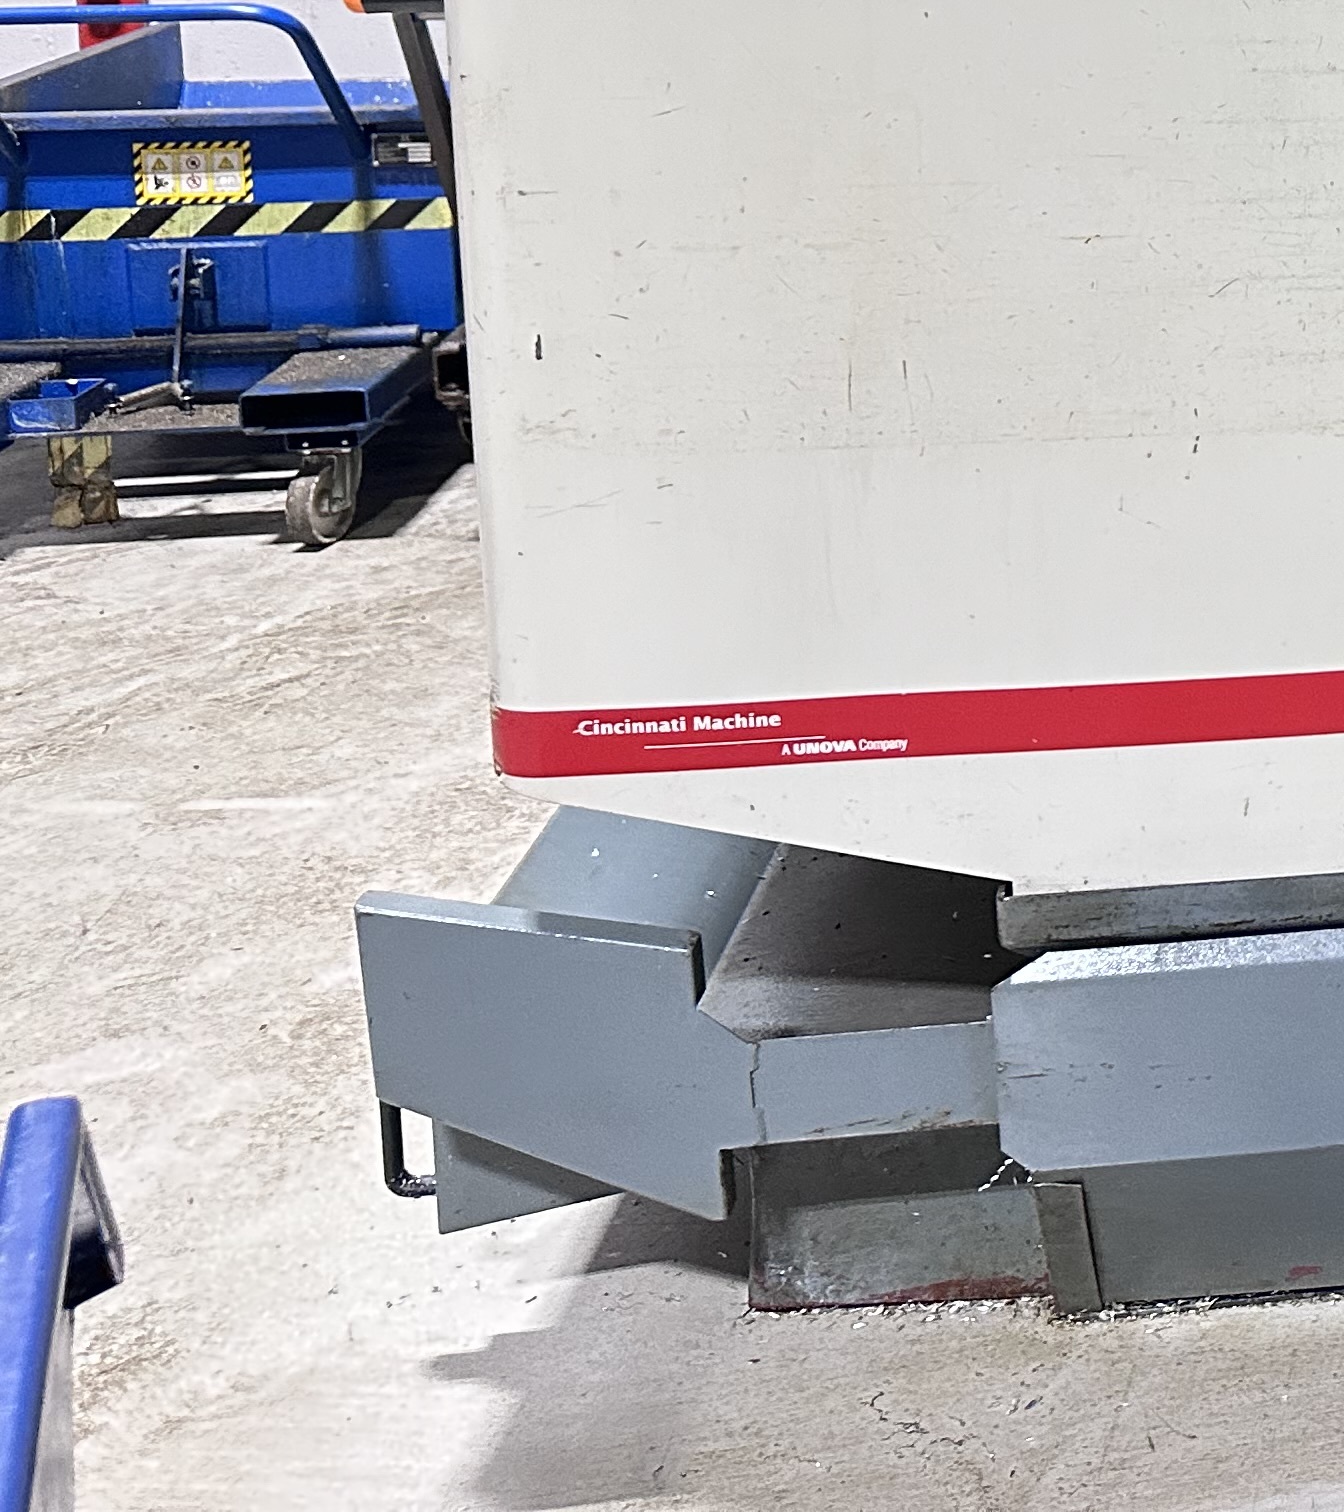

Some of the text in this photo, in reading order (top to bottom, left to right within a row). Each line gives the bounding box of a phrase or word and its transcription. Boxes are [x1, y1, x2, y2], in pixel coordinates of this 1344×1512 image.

[574, 712, 782, 736] Cincinnati Machine
[781, 738, 909, 756] A UNOVA Company
